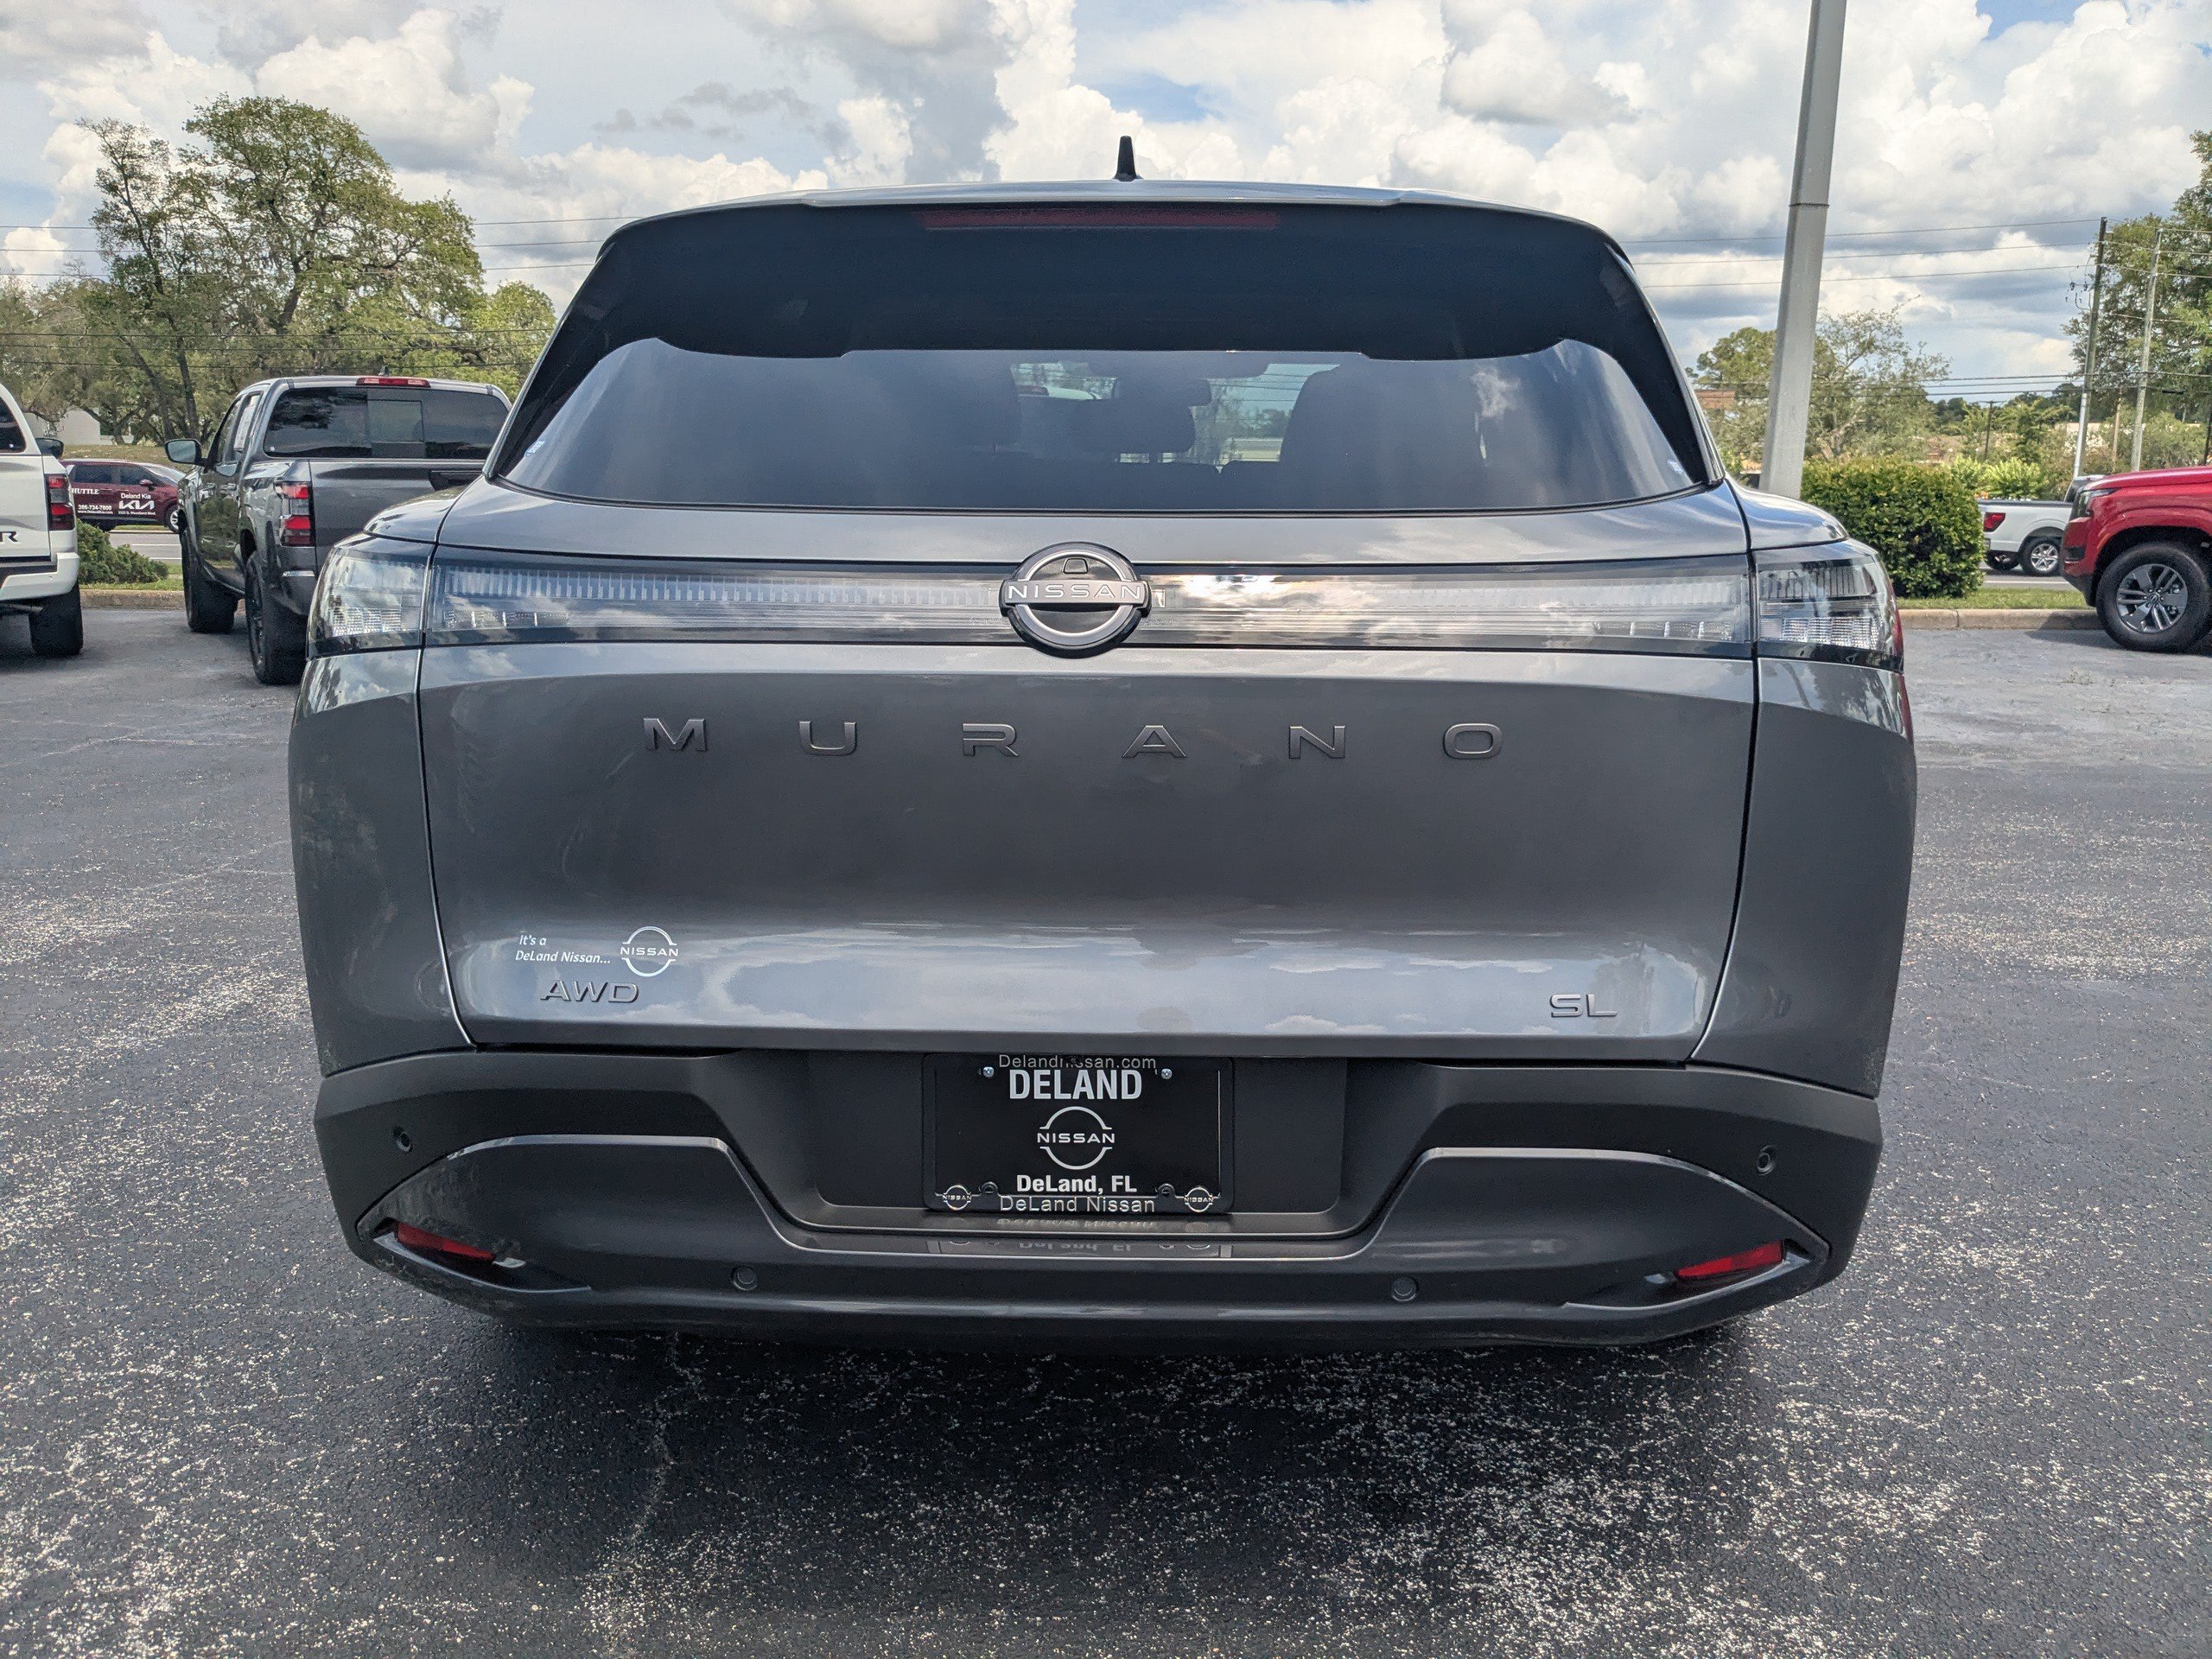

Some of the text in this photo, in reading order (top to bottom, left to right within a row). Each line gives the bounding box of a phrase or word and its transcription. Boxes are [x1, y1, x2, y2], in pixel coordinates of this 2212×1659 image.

[118, 500, 155, 510] KIA
[1007, 583, 1141, 600] NISSAN
[643, 718, 1503, 760] MURANO
[519, 935, 547, 946] It's a
[515, 950, 611, 964] DeLand Nissan...
[620, 946, 678, 957] NISSAN
[540, 979, 639, 1004] AWD
[1549, 994, 1618, 1018] SL
[1009, 1069, 1142, 1100] DELAND
[1037, 1132, 1116, 1144] NISSAN
[1016, 1174, 1137, 1195] DeLand, FL
[1000, 1195, 1155, 1212] DeLand Nissan
